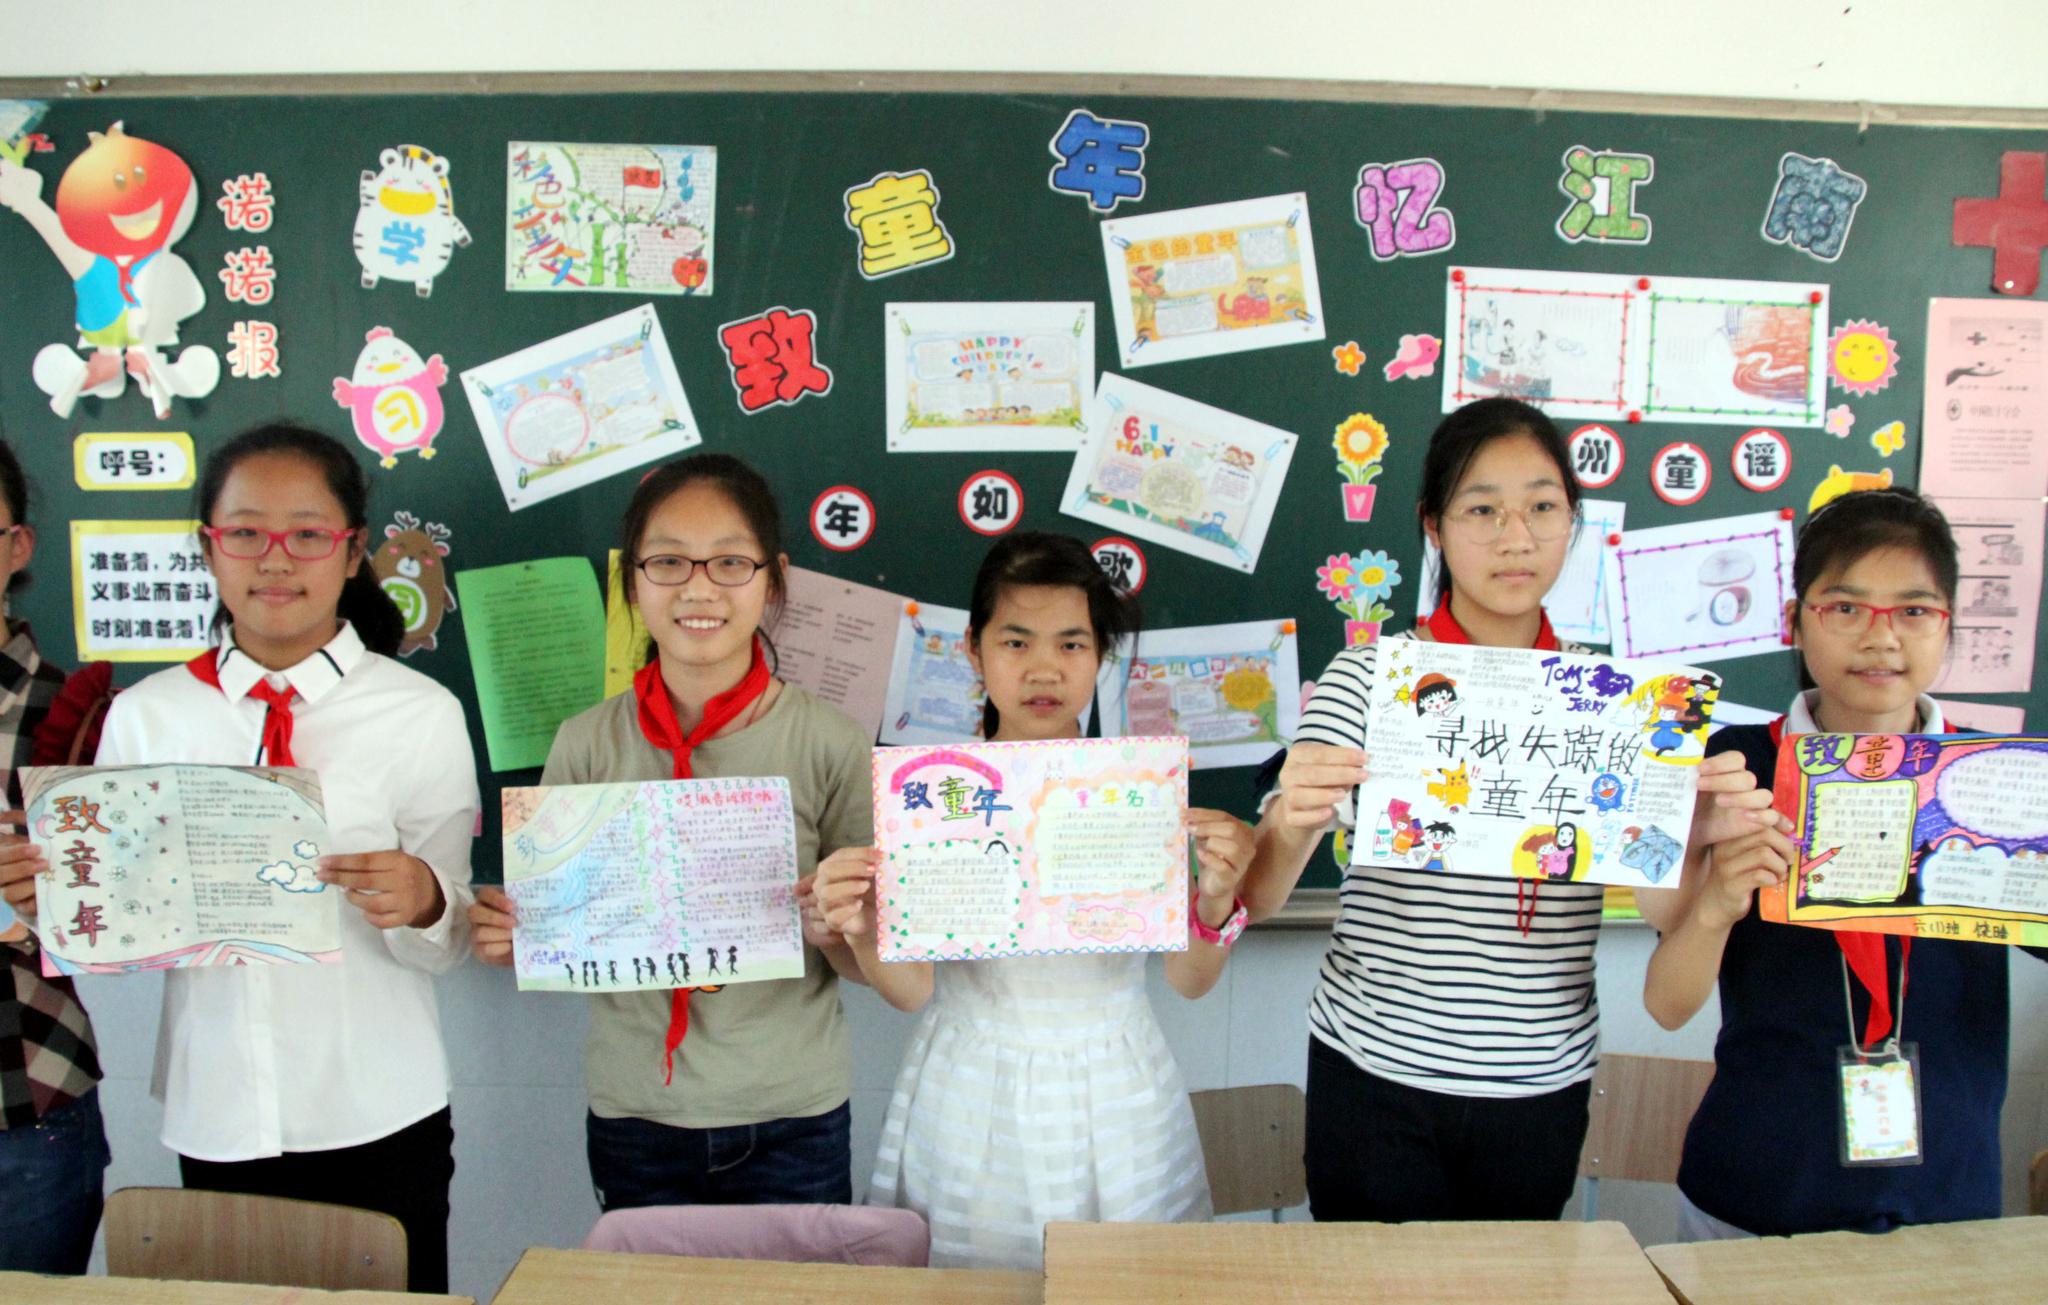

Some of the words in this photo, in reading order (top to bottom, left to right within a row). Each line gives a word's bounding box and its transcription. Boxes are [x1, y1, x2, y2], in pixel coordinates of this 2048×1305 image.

[1051, 110, 1148, 211] 年
[1356, 159, 1454, 259] 忆
[1558, 147, 1652, 243] 江
[378, 219, 427, 266] 学
[846, 171, 953, 278] 童
[218, 173, 281, 379] 诺诺报
[722, 308, 832, 412] 致
[378, 390, 420, 433] 习
[1115, 438, 1175, 461] HAPPY
[1577, 437, 1611, 475] 州
[1662, 453, 1698, 491] 童
[1743, 440, 1778, 478] 谣
[823, 500, 861, 539] 年
[971, 485, 1009, 520] 如
[92, 582, 212, 601] 义事业而奋斗
[1425, 715, 1643, 776] 寻找失踪的
[902, 776, 1013, 826] 致童年
[1469, 770, 1586, 827] 童年
[52, 796, 112, 946] 致童年
